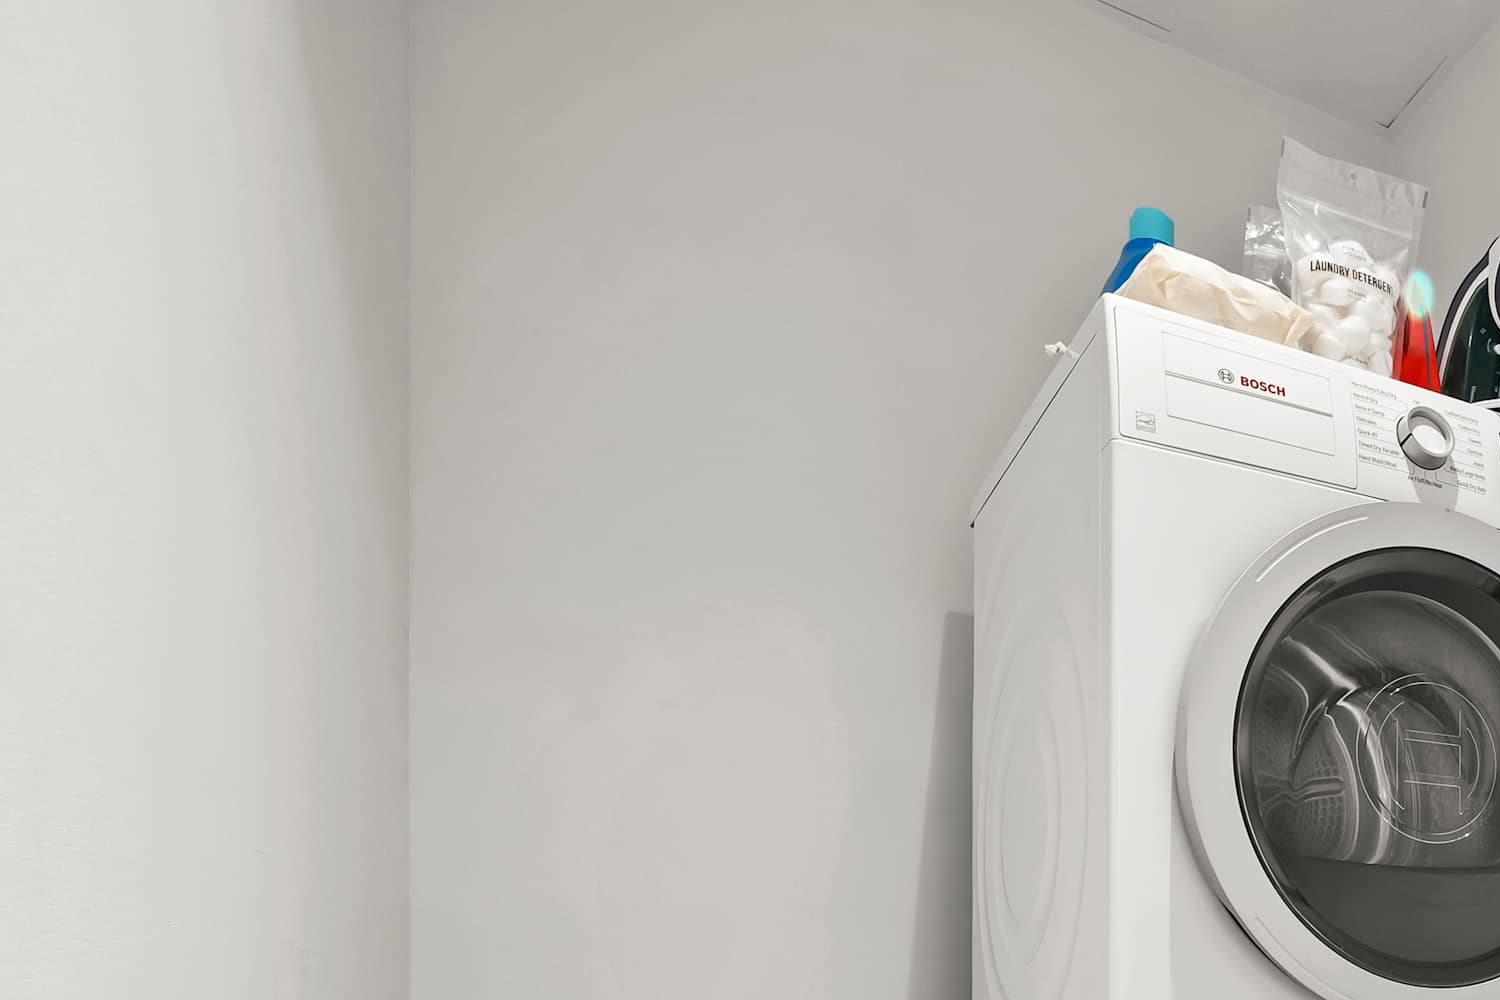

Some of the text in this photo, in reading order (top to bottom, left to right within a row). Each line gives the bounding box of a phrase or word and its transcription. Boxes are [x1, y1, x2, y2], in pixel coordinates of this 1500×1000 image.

[1310, 260, 1350, 277] LAUNDRY
[1352, 269, 1393, 296] DETERGEN
[1240, 376, 1286, 397] BOSCH
